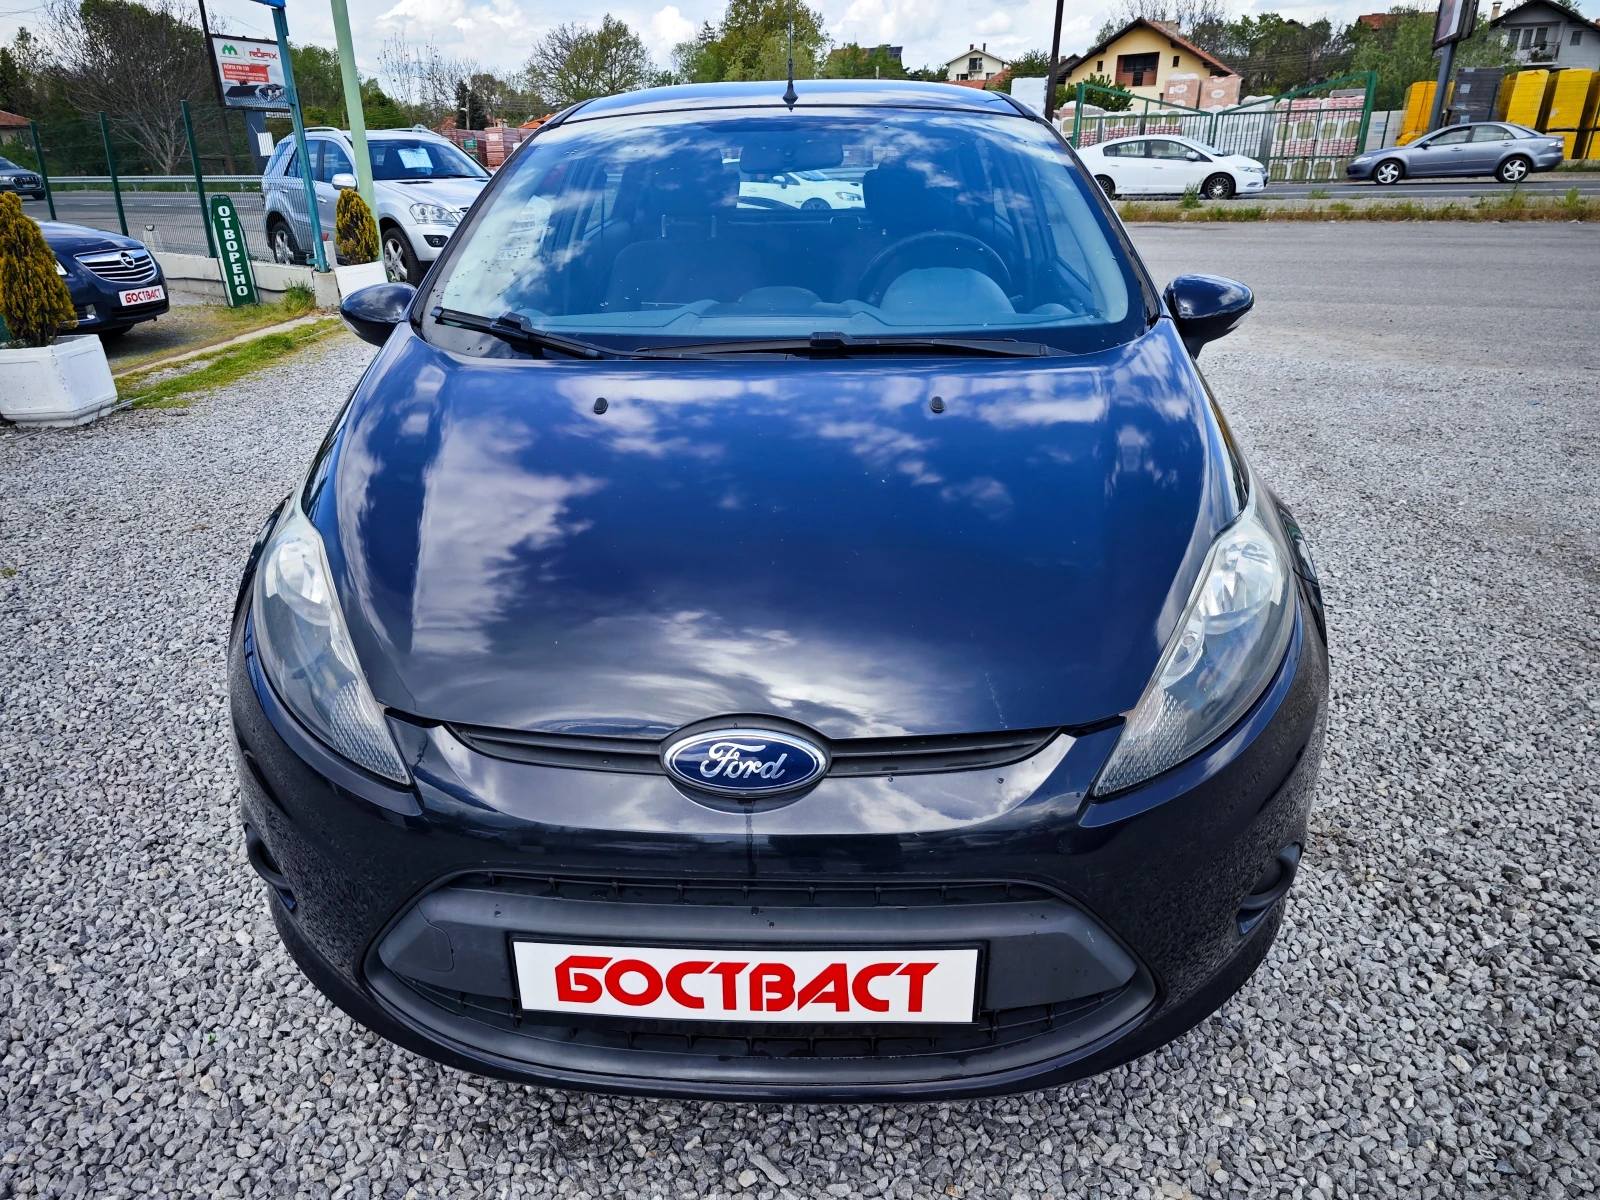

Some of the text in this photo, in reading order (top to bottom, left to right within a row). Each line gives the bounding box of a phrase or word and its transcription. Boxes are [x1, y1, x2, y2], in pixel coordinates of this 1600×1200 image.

[218, 206, 248, 296] ОТВОРЕНО
[125, 289, 161, 303] БОСТВАСТ
[700, 742, 788, 780] Ford
[555, 955, 940, 1012] БОСТВАСТ
